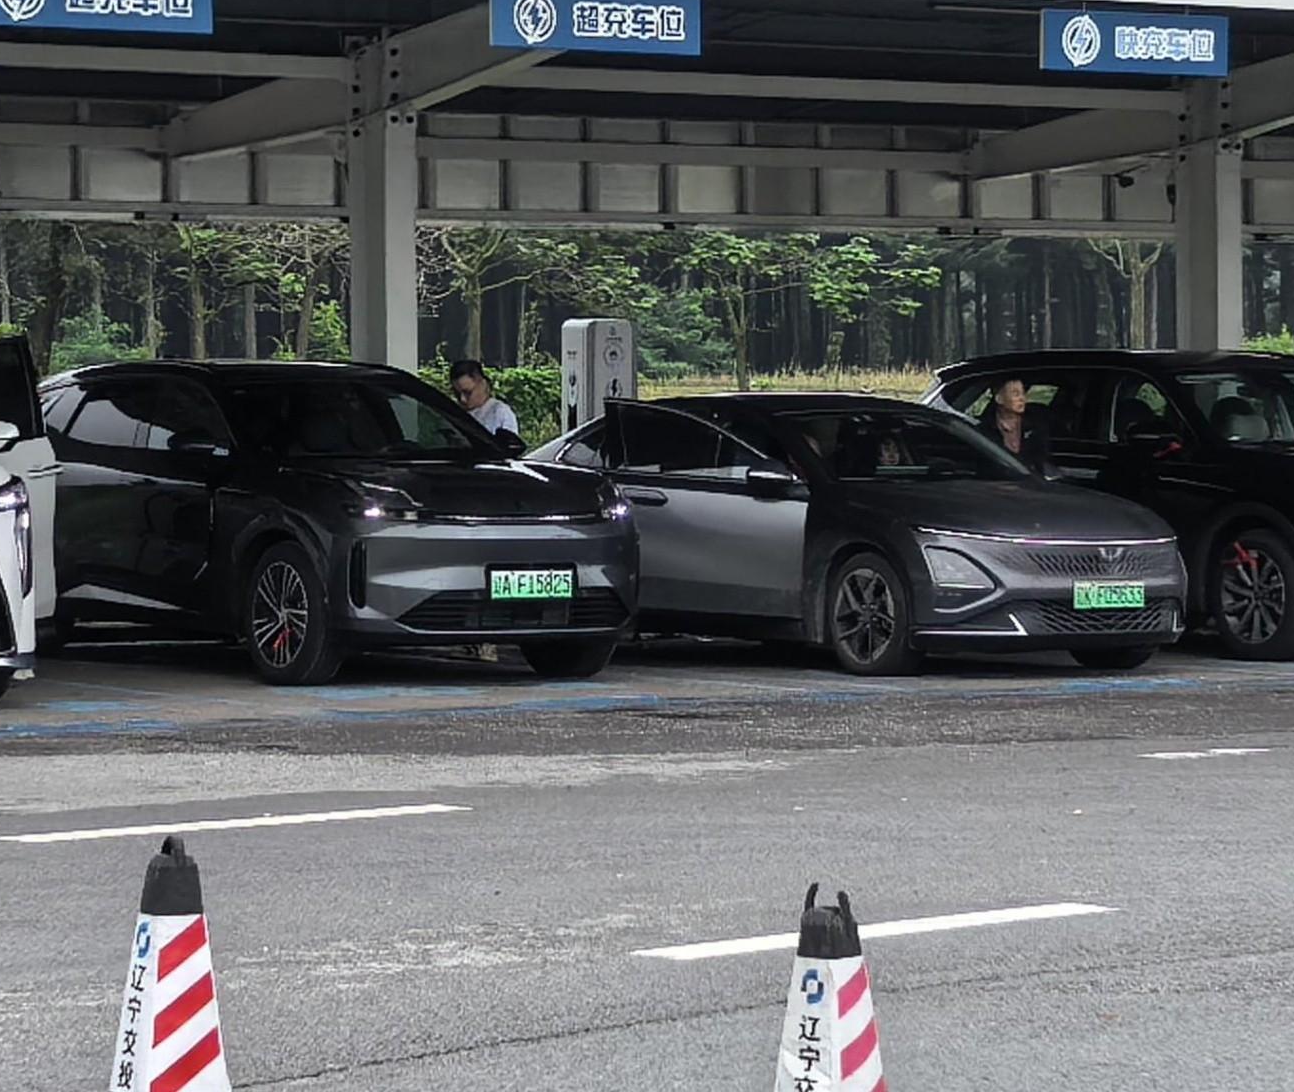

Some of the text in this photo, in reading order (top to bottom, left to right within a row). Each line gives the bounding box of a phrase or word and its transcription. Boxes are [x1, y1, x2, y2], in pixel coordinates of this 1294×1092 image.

[572, 0, 686, 42] 超充车位
[1114, 26, 1215, 63] 快充车位
[117, 964, 147, 1091] 辽宁交投
